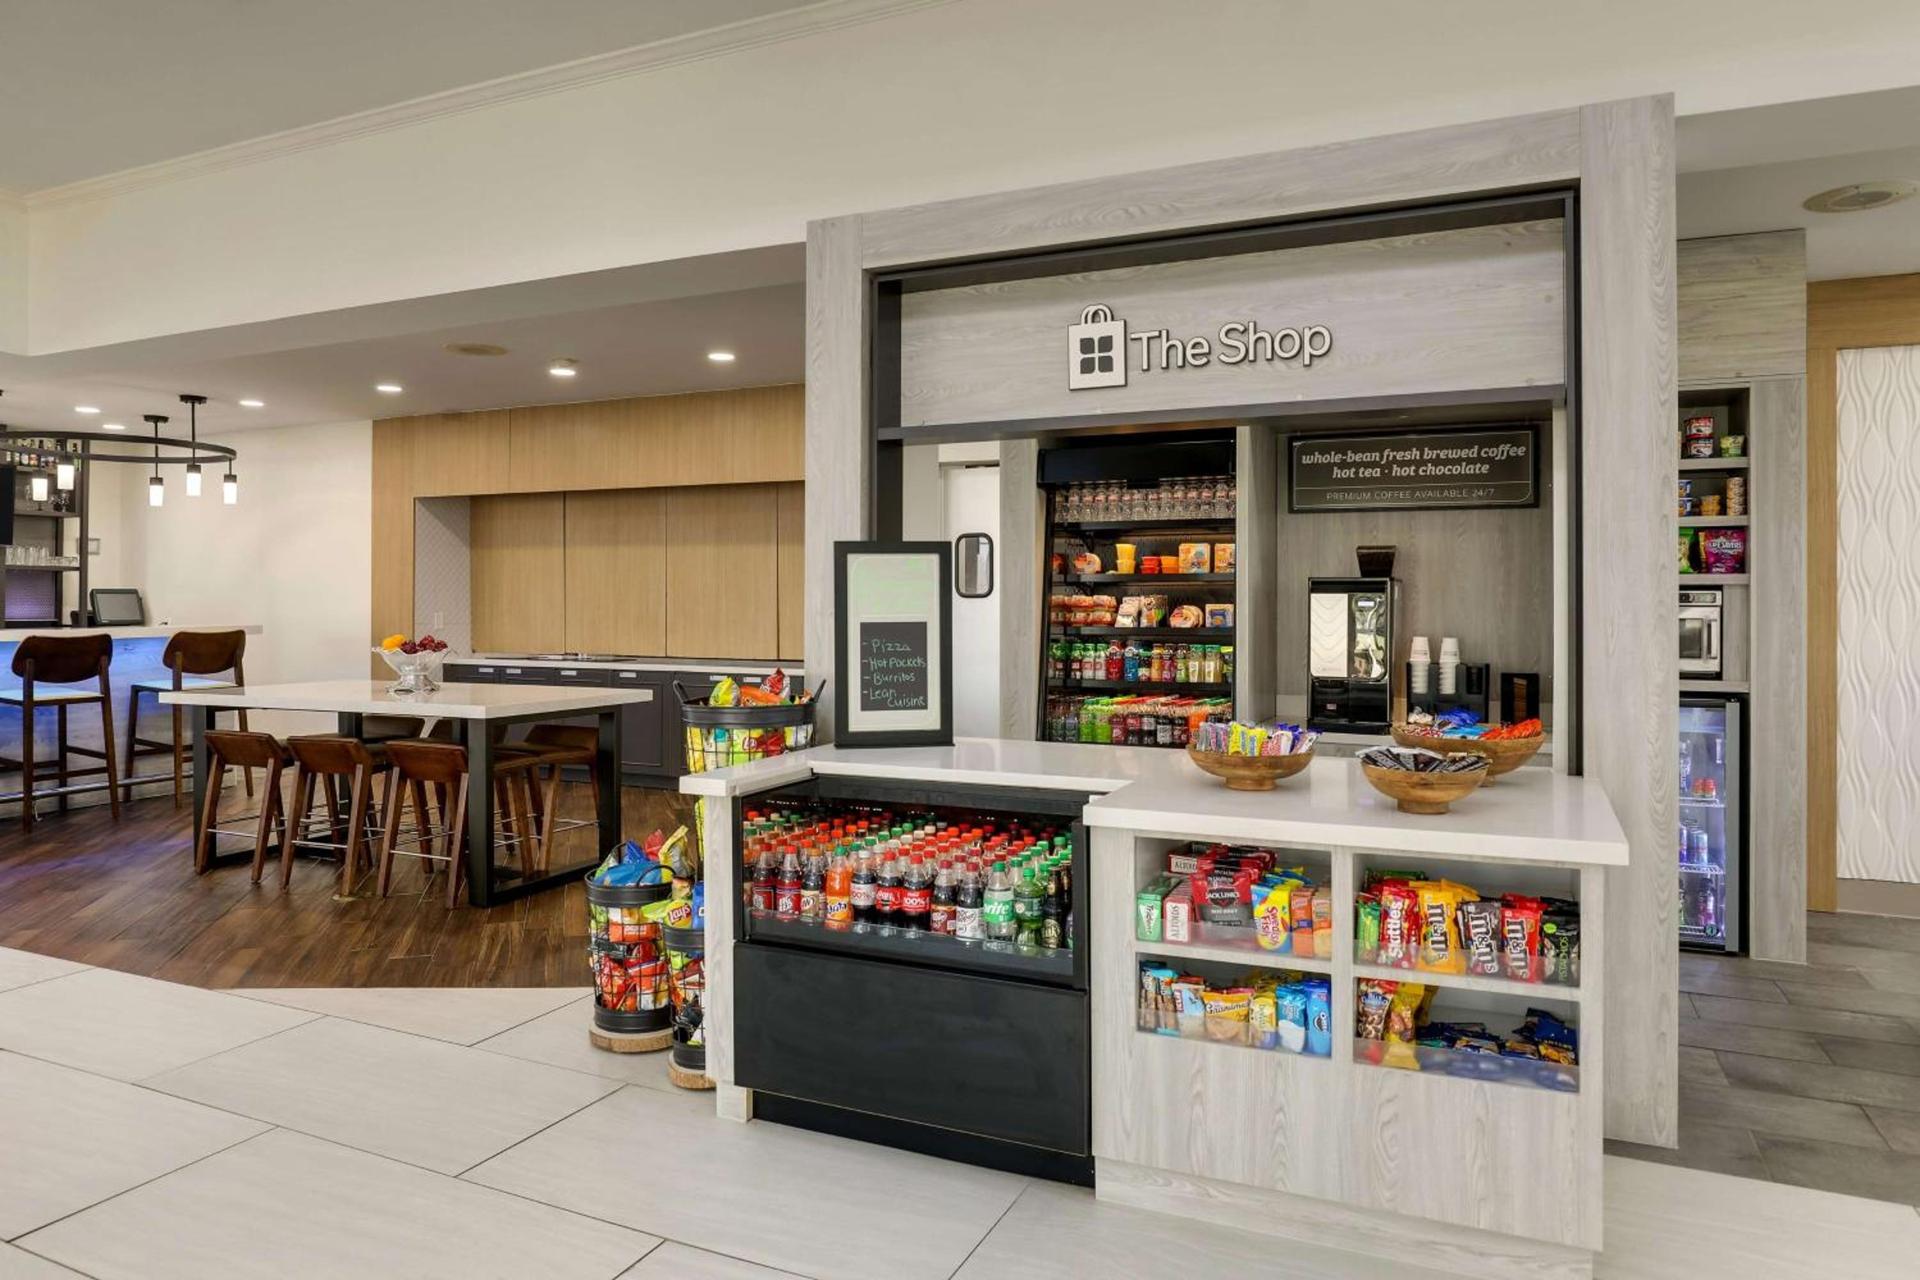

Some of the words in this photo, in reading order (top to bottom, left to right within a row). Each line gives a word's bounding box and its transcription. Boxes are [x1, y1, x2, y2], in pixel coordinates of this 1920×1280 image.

[1130, 328, 1211, 372] The
[1217, 320, 1333, 367] Shop
[1301, 450, 1380, 465] whole-bean
[1381, 447, 1421, 465] fresh
[1424, 445, 1479, 460] brewed
[1481, 443, 1527, 460] coffee
[1332, 465, 1356, 478] hot
[1359, 466, 1382, 478] tea
[1392, 464, 1416, 477] hot
[1419, 462, 1490, 476] chocolate
[1326, 491, 1372, 501] PREMIUM
[1374, 490, 1412, 500] COFFEE
[1414, 489, 1468, 499] AVAILABLE
[1471, 488, 1495, 498] 24/7
[871, 638, 912, 653] Pizza
